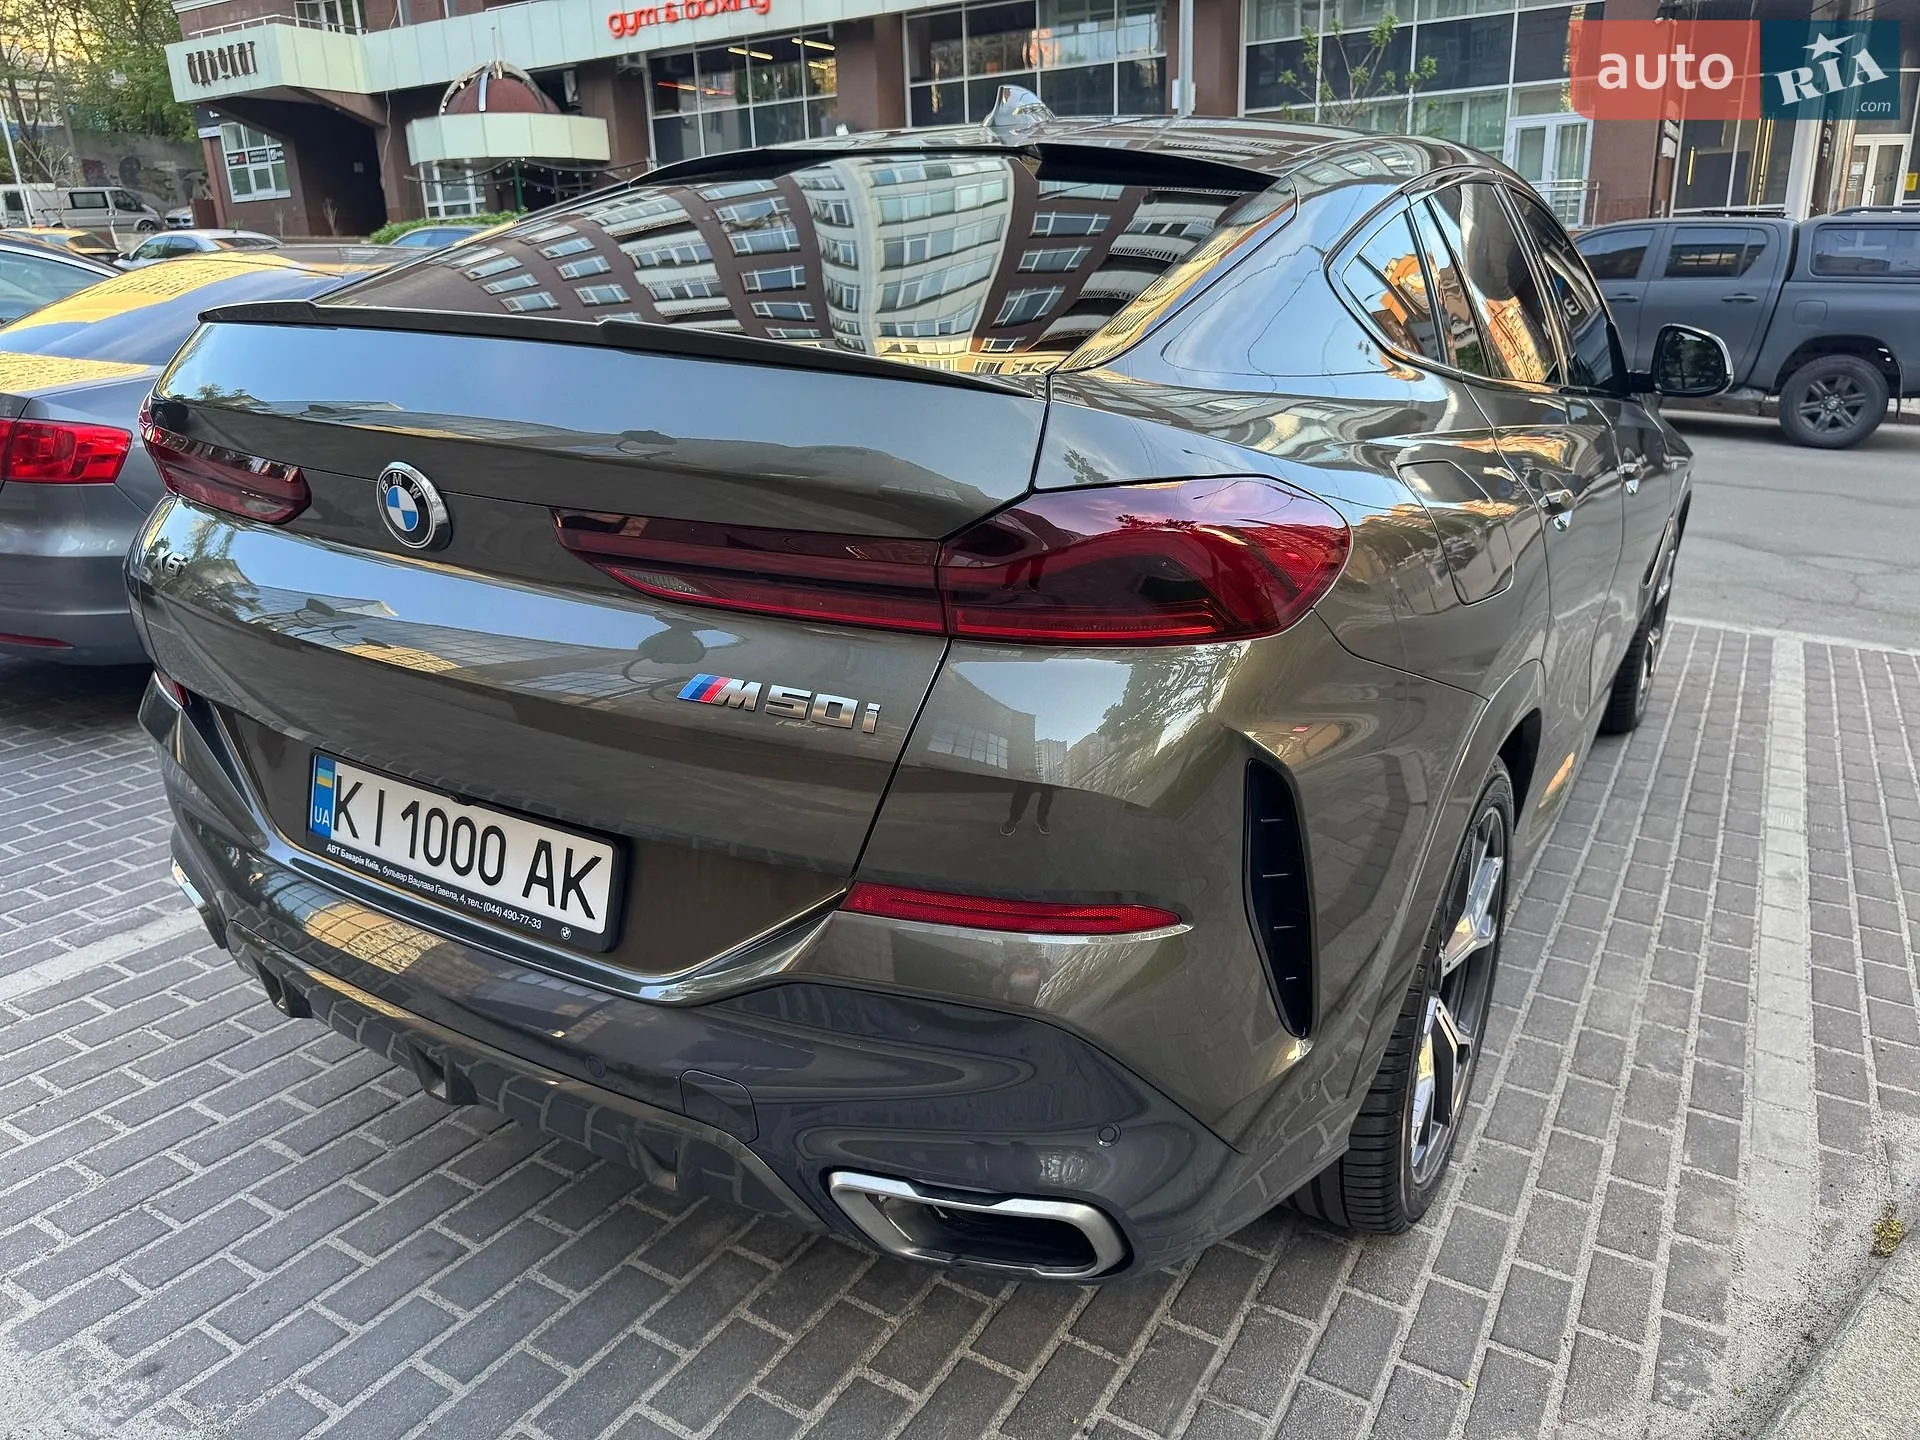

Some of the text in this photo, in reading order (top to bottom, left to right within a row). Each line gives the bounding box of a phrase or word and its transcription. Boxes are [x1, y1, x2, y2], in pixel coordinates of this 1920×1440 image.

[608, 7, 660, 38] gym
[381, 473, 423, 500] BMW
[314, 805, 331, 828] UA
[401, 800, 507, 886] 1000
[365, 858, 381, 873] Київ,
[382, 865, 408, 883] бульвар
[435, 884, 459, 902] Гавела,
[483, 901, 503, 917] (044)
[503, 909, 542, 930] 490-77-33
